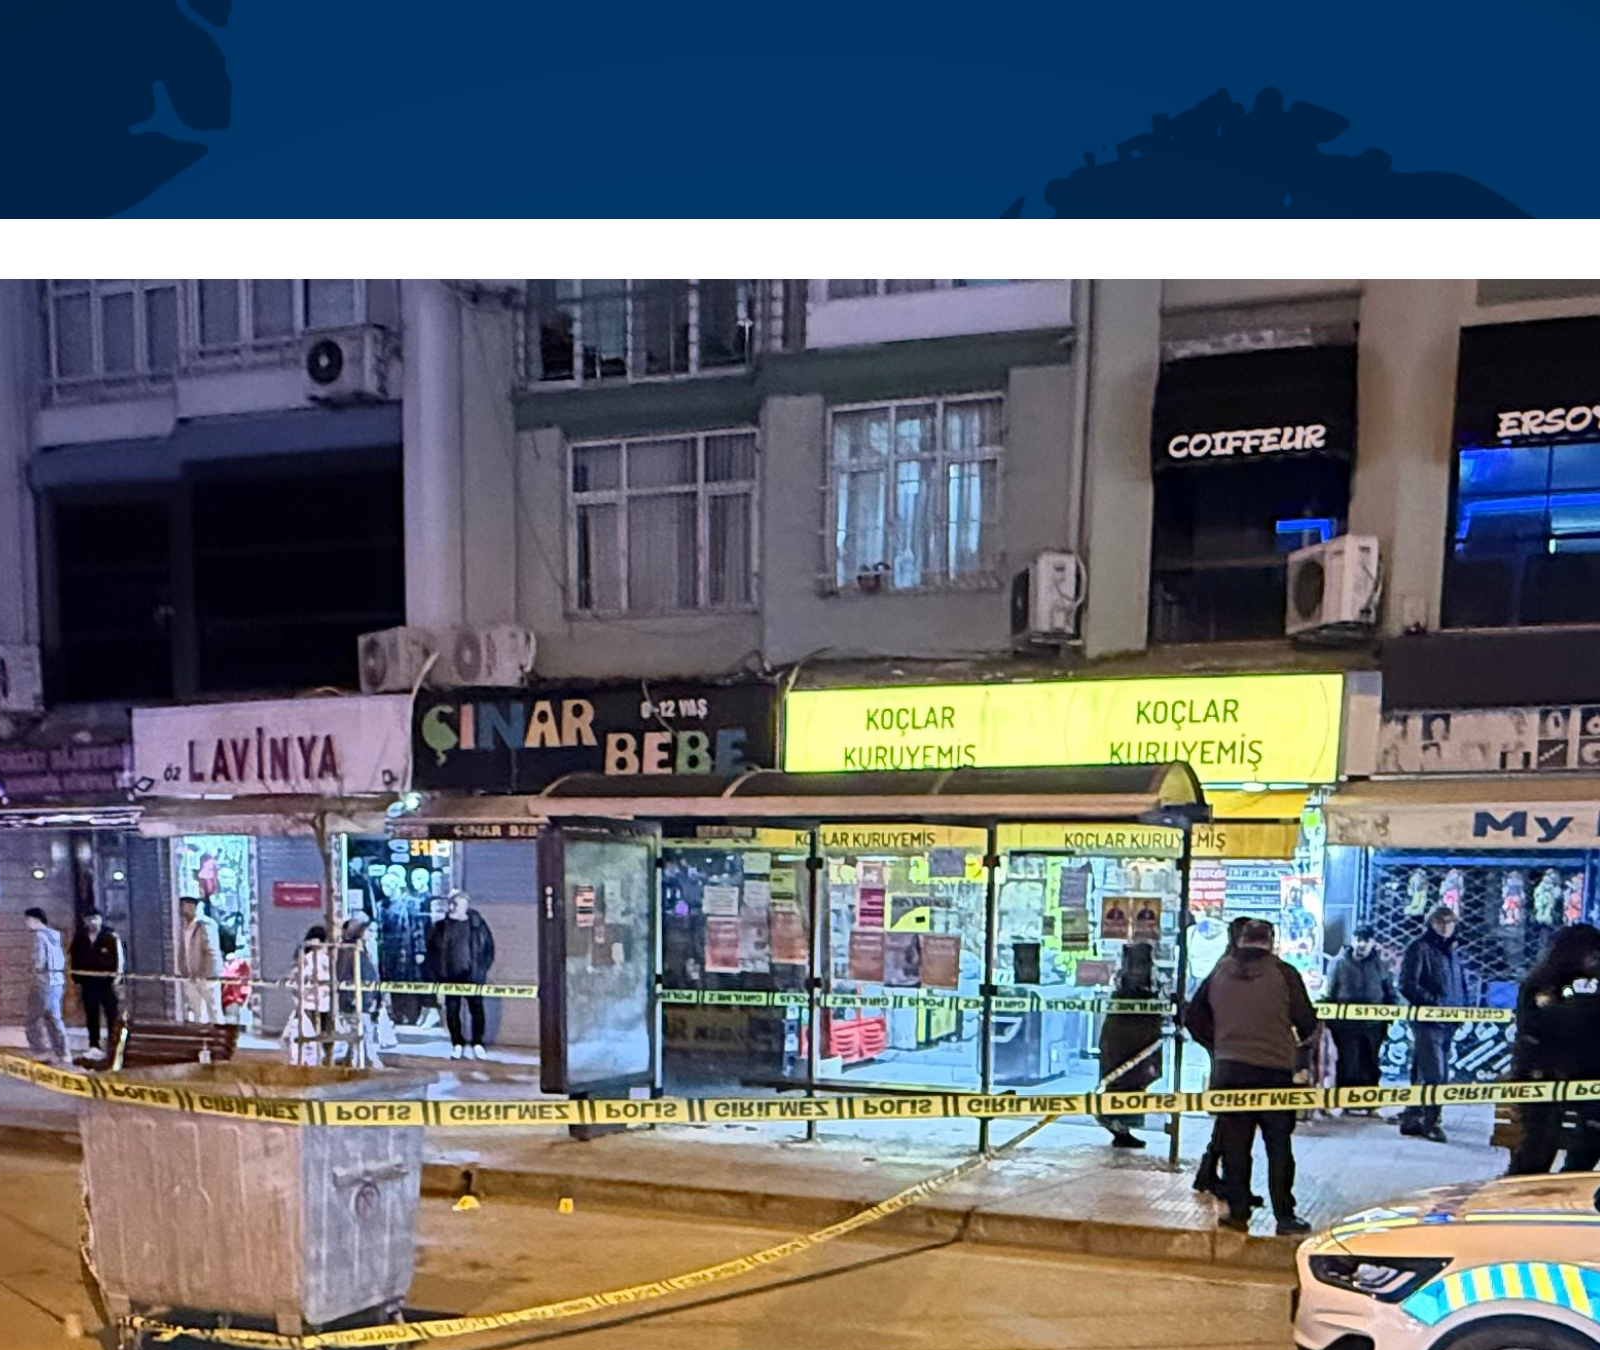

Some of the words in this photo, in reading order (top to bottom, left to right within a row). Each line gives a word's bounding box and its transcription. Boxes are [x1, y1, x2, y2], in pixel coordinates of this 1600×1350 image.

[1167, 423, 1326, 460] COIFFEUR
[640, 700, 675, 720] 0-12
[866, 706, 956, 737] KOÇLAR
[1136, 698, 1240, 732] KOÇLAR
[421, 699, 599, 767] ÇINAR
[188, 727, 343, 783] LAVİNYA
[605, 729, 749, 777] BEBE
[1109, 733, 1264, 772] KURUYEMİŞ
[1473, 809, 1575, 843] My
